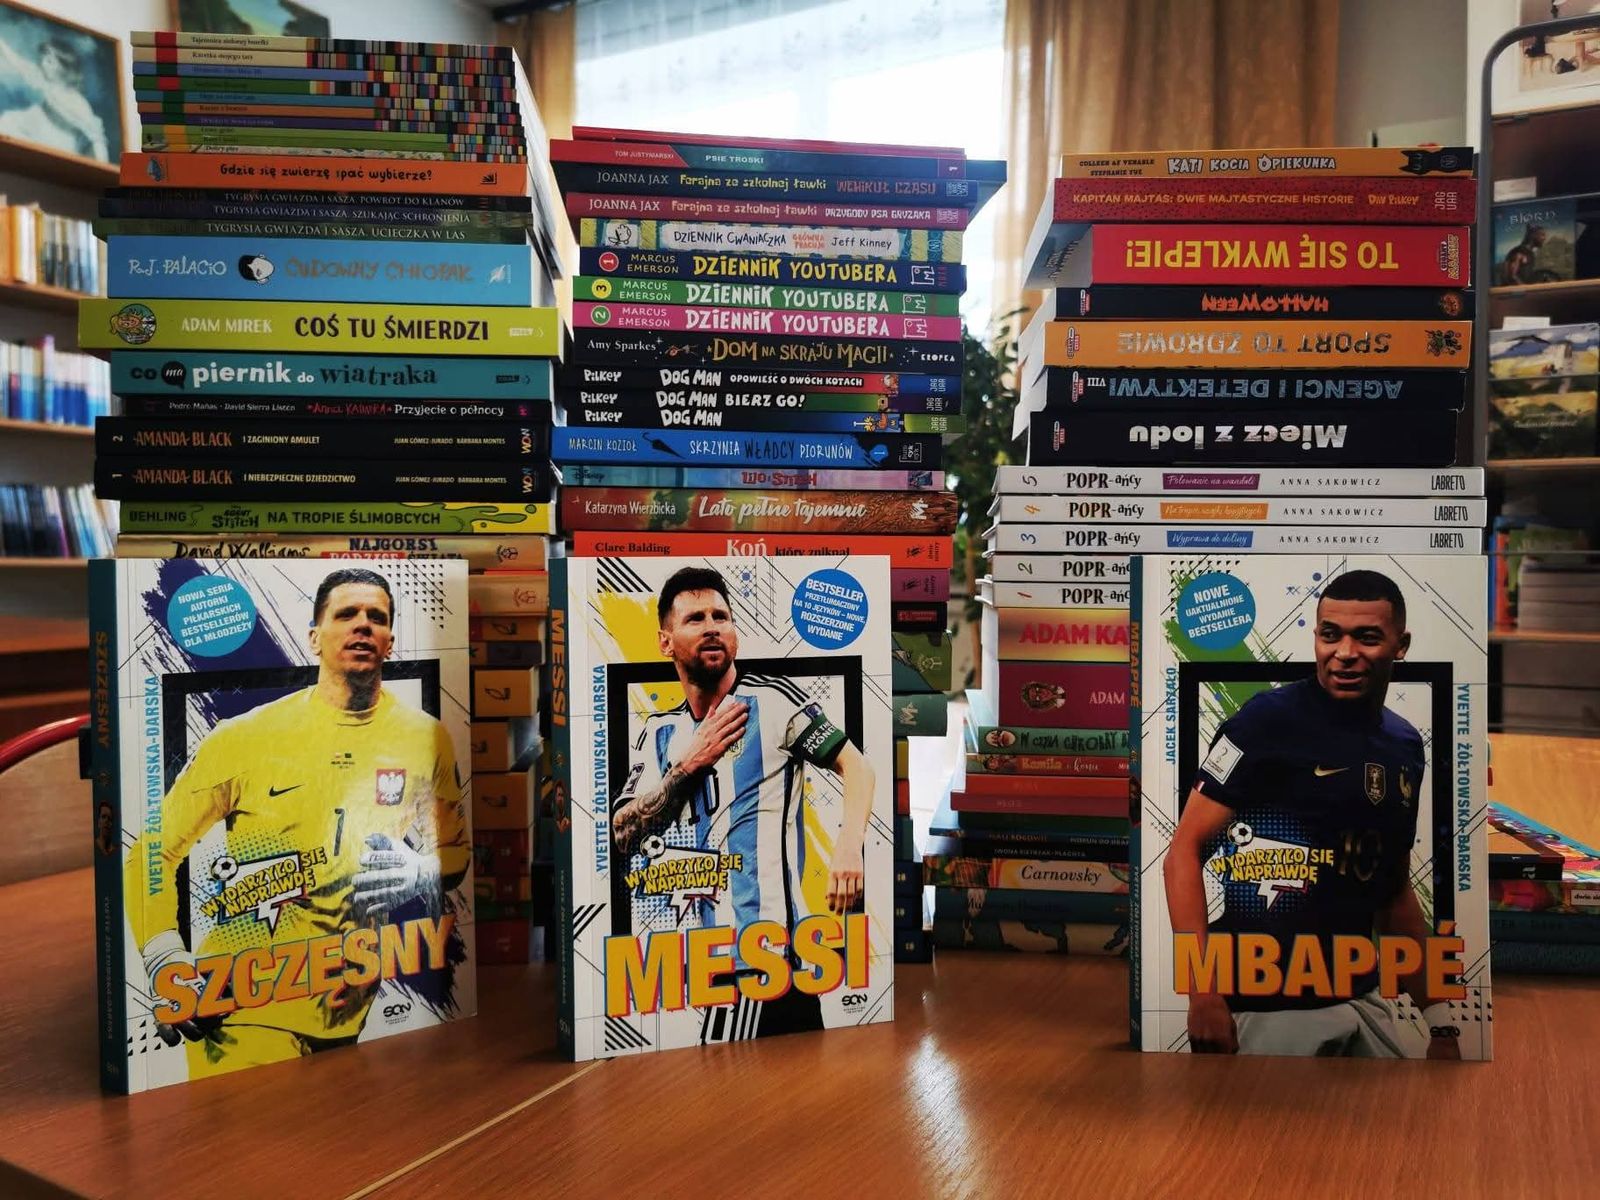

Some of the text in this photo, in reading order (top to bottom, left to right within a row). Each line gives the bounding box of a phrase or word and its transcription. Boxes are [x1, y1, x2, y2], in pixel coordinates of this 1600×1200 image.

[730, 156, 764, 164] TROSKI
[1168, 154, 1336, 175] KATI KOCIA OPIEKUNKA
[220, 164, 256, 176] Gdzie
[259, 165, 277, 178] się
[281, 166, 330, 179] zwierzę
[368, 168, 432, 182] wybierze?
[597, 172, 669, 185] JOANNA JAX
[680, 174, 721, 189] Ferajna
[725, 177, 739, 188] ze
[742, 178, 789, 191] szkolnej
[794, 178, 827, 192] ławki
[837, 179, 890, 194] WEHIKUŁ
[895, 181, 937, 195] CZASU
[589, 198, 660, 211] JOANNA JAX
[1073, 194, 1354, 203] KAPITAN MAJTAS: DWIE MAJTASTYCZNE HISTORIE
[831, 236, 892, 250] Jeff Kinney
[1125, 233, 1400, 270] TO SIĘ WYKLEPIE!
[630, 253, 676, 264] MARCUS
[627, 264, 679, 275] EMERSON
[693, 255, 781, 280] DZIENNIK
[789, 261, 898, 283] YOUTUBERA
[622, 280, 668, 291] MARCUS
[619, 291, 671, 302] EMERSON
[685, 283, 890, 313] DZIENNIK YOUTUBERA
[1201, 289, 1329, 312] HALLOWEEN
[618, 317, 670, 327] EMERSON
[622, 307, 667, 317] MARCUS
[182, 317, 273, 334] ADAM MIREK
[294, 314, 489, 341] COŚ TU ŚMIERDZI
[685, 309, 890, 337] DZIENNIK YOUTUBERA
[587, 339, 656, 352] Amy Sparkes
[1117, 330, 1392, 355] SPORT TO ZDROWIE
[712, 338, 887, 368] DOM NA SKRAJU MAGII
[130, 360, 438, 388] co ma piernik do wiatraka
[660, 369, 864, 387] DOG MAN OPOWIEŚĆ O DWÓCH KOTACH
[1109, 378, 1404, 399] AGENCI I DETEKTYWI
[656, 391, 806, 408] DOG MAN BIERZ GO!
[660, 409, 723, 427] DOG MAN
[133, 431, 232, 447] AMANDA BLACK
[569, 437, 638, 452] MARCIN KOZIOŁ
[1129, 424, 1348, 451] Miecz z lodu
[690, 440, 853, 460] SKRZYNIA WŁADCY PIORUNÓW
[133, 469, 233, 485] AMANDA BLACK
[1066, 472, 1141, 490] POPR-ańcy
[1280, 478, 1381, 487] ANNA SAKOWICZ
[1431, 475, 1466, 491] LABRETO
[129, 511, 187, 523] BEHLING
[267, 509, 440, 525] NA TROPIE ŚLIMOBCYCH
[585, 501, 676, 516] Katarzyna Wierzbicka
[698, 495, 867, 524] Lato pełne tajemnic
[1283, 507, 1384, 517] ANNA SAKOWICZ
[1434, 505, 1469, 521] LABRETO
[212, 515, 259, 528] STITCH
[173, 541, 311, 558] David Walliams
[595, 543, 671, 555] Clare Balding
[1279, 535, 1380, 545] ANNA SAKOWICZ
[1430, 532, 1464, 548] LABRETO
[178, 583, 234, 604] NOWA SERIA
[805, 578, 864, 602] BESTSELLER
[1193, 584, 1230, 604] NOWE
[190, 595, 228, 613] AUTORKI
[804, 591, 861, 613] PRZETŁUMACZONY
[1185, 594, 1245, 617] UAKTUALNIONE
[183, 603, 241, 625] PIŁKARSKICH
[800, 610, 855, 632] ROZSZERZONE
[1199, 607, 1236, 625] WYDANIE
[181, 611, 250, 638] BESTSELLERÓW
[184, 621, 252, 648] DLA MŁODZIEŻY
[807, 624, 844, 642] WYDANIE
[1188, 613, 1253, 639] BESTSELLERA
[551, 608, 568, 727] MESSI
[1131, 621, 1142, 708] MBAPPÉ
[1089, 692, 1125, 705] ADAM
[591, 664, 610, 874] YVETTE ŻÓŁTOWSKA-DARSKA
[143, 674, 165, 898] YVETTE ŻÓŁTOWSKA-DARSKA
[624, 853, 743, 889] WYDARZYŁO SIĘ
[1209, 847, 1335, 877] WYDARZYŁO SIĘ
[199, 846, 328, 919] WYDARZYŁO SIĘ
[645, 870, 729, 895] NAPRAWDĘ
[1021, 865, 1102, 885] Carnovsky
[1231, 863, 1318, 885] NAPRAWDĘ
[226, 868, 316, 917] NAPRAWDĘ
[153, 913, 457, 1026] SZCZĘSNY
[604, 912, 870, 1019] MESSI
[1173, 919, 1466, 1001] MBAPPÉ
